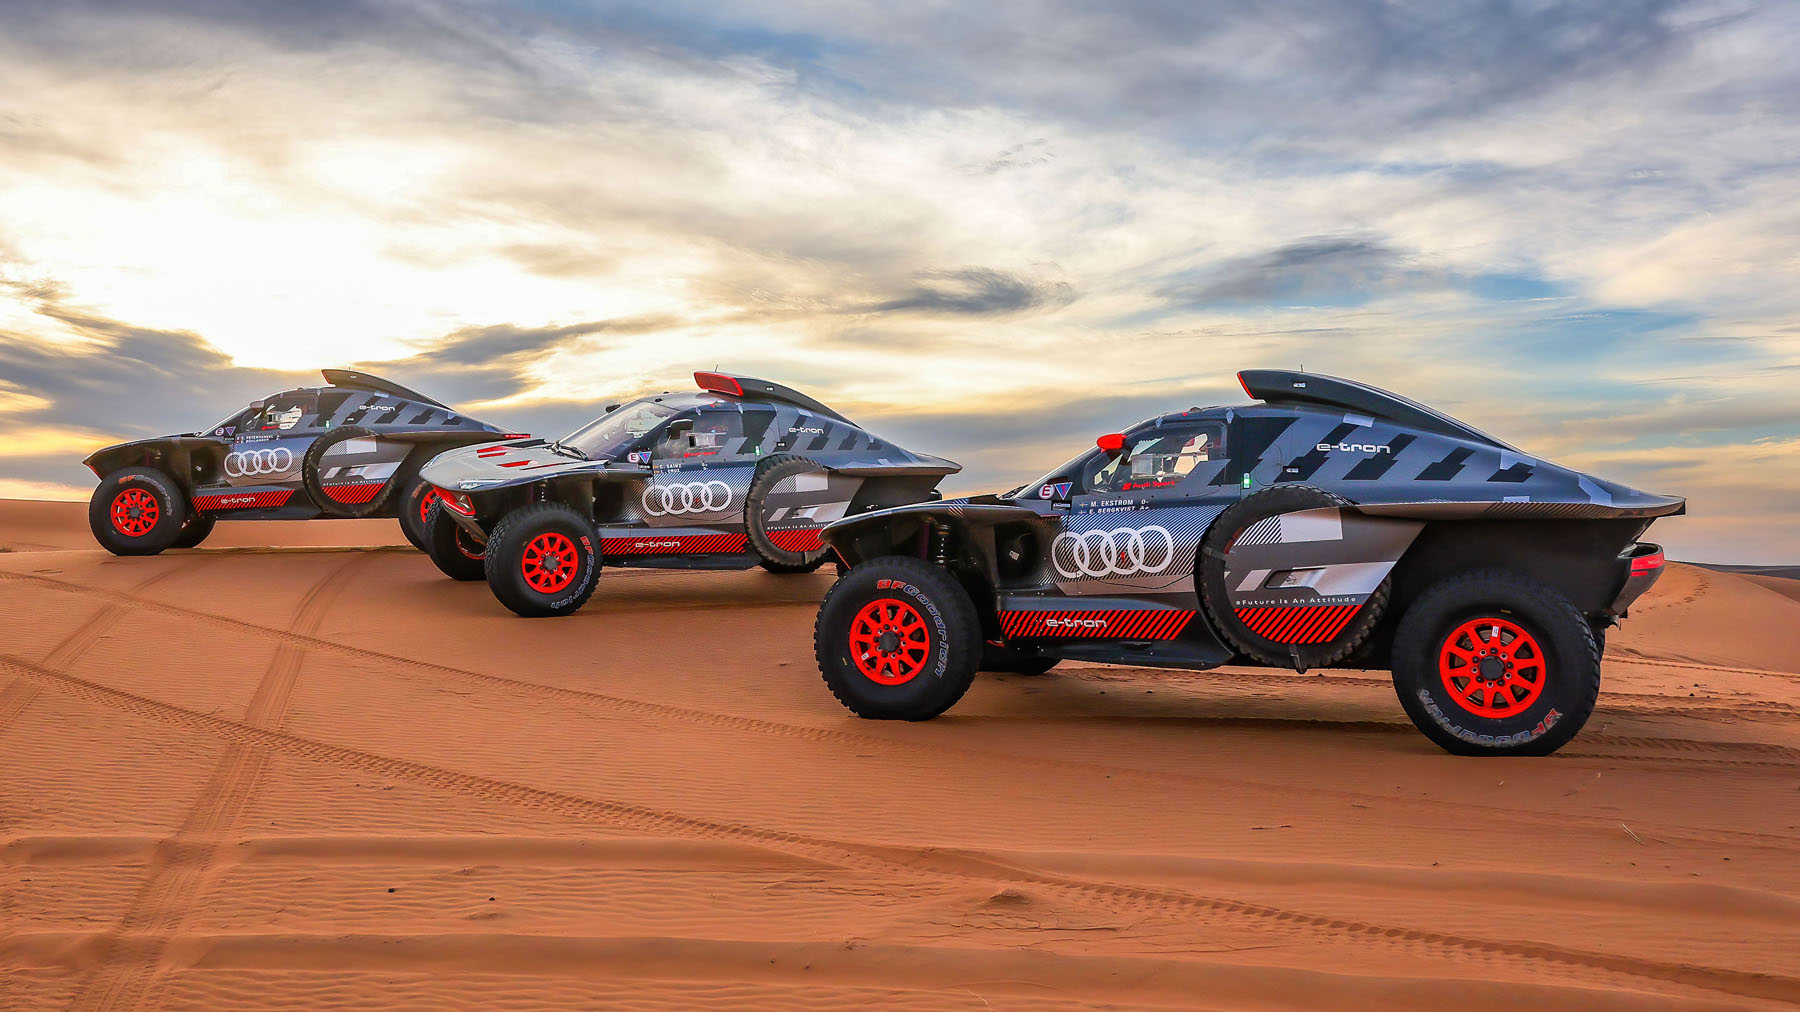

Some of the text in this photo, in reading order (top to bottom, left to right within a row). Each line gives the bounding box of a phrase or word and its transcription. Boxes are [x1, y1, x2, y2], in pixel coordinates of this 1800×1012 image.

[359, 404, 396, 412] e-tron
[788, 426, 824, 434] e-tron
[1316, 442, 1391, 454] e-tron
[1152, 480, 1175, 488] Sport
[220, 496, 256, 504] e-tron
[635, 540, 681, 548] e-tron
[1046, 617, 1107, 628] e-tron
[876, 579, 949, 679] BFGoodrich
